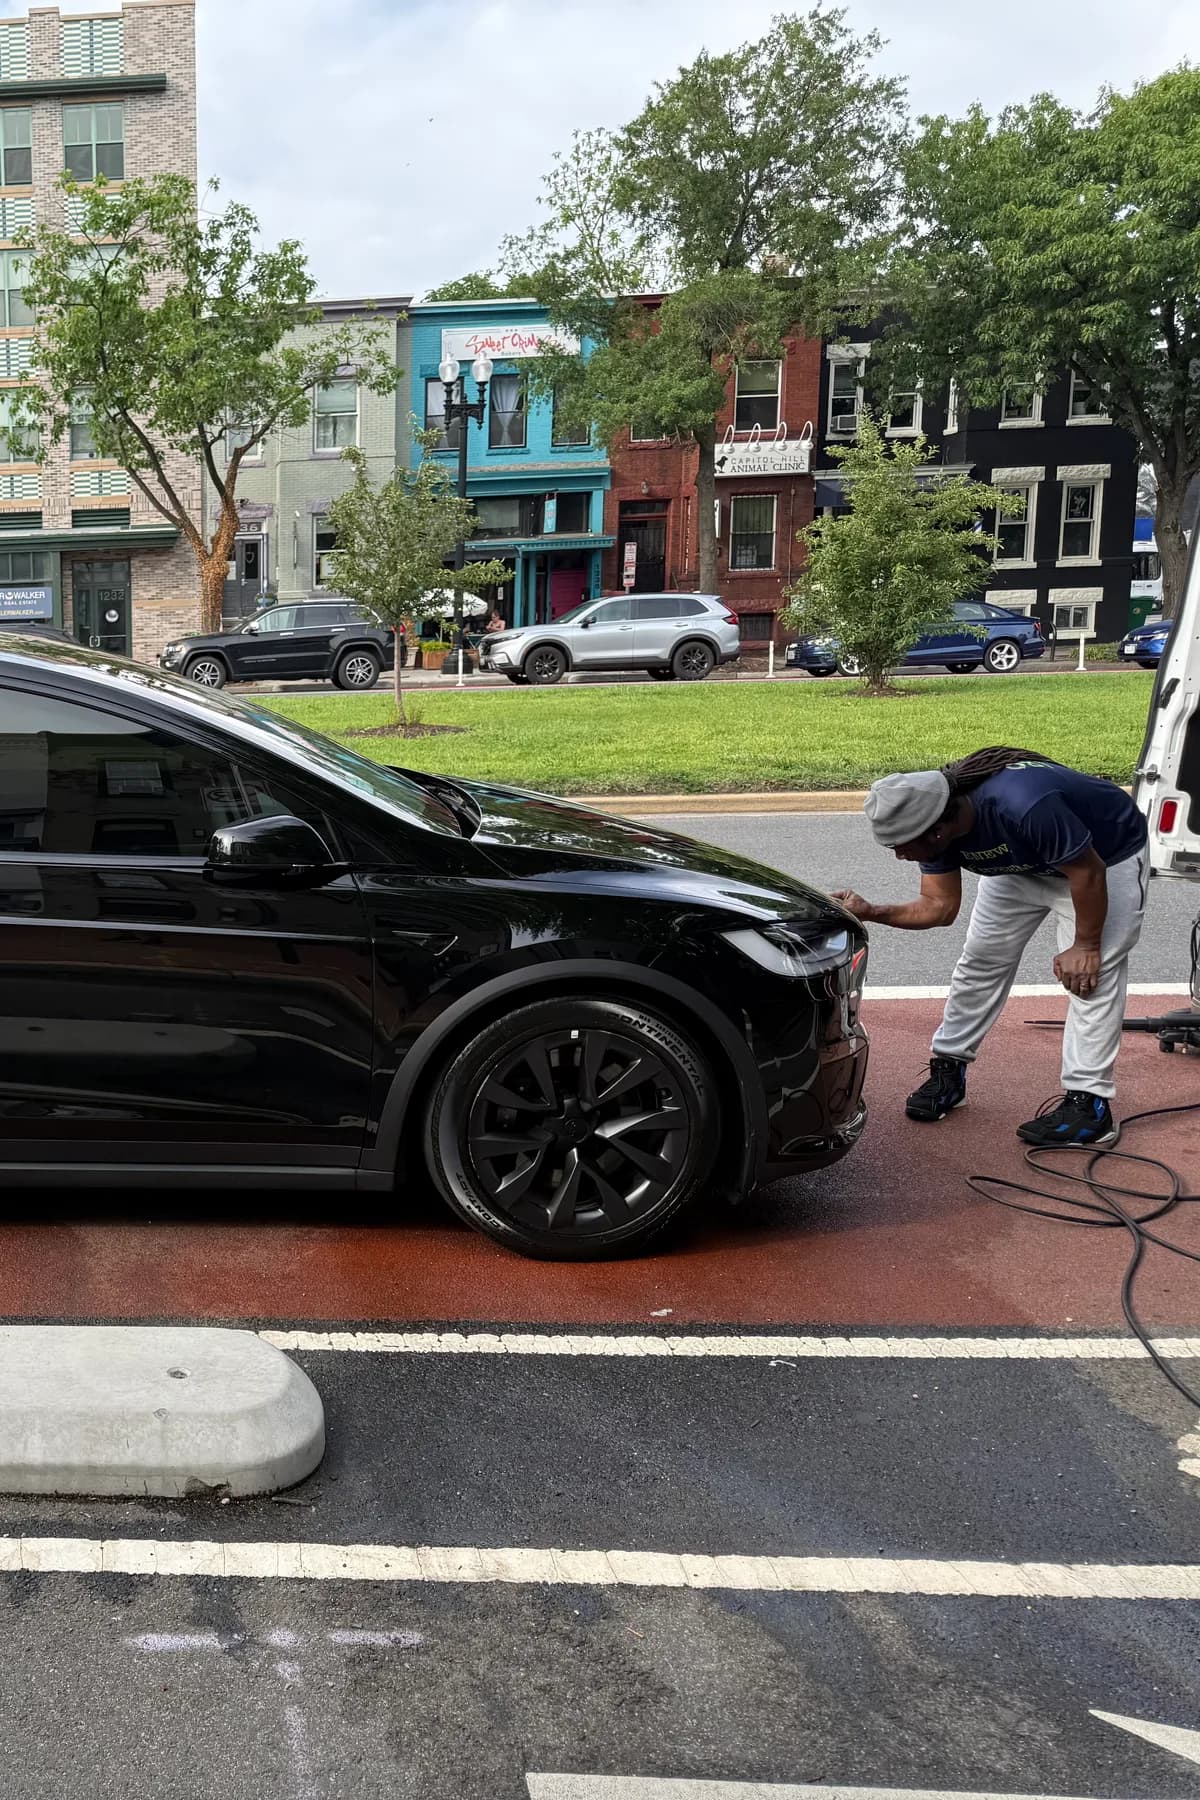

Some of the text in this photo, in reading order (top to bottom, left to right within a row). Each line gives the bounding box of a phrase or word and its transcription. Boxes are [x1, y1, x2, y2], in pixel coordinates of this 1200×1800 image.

[730, 455, 803, 464] CAPITOL HILL
[731, 462, 805, 473] ANIMAL CLINIC
[13, 591, 46, 600] WALKER
[99, 591, 125, 601] 1232
[607, 1011, 704, 1097] CONTINENTAL
